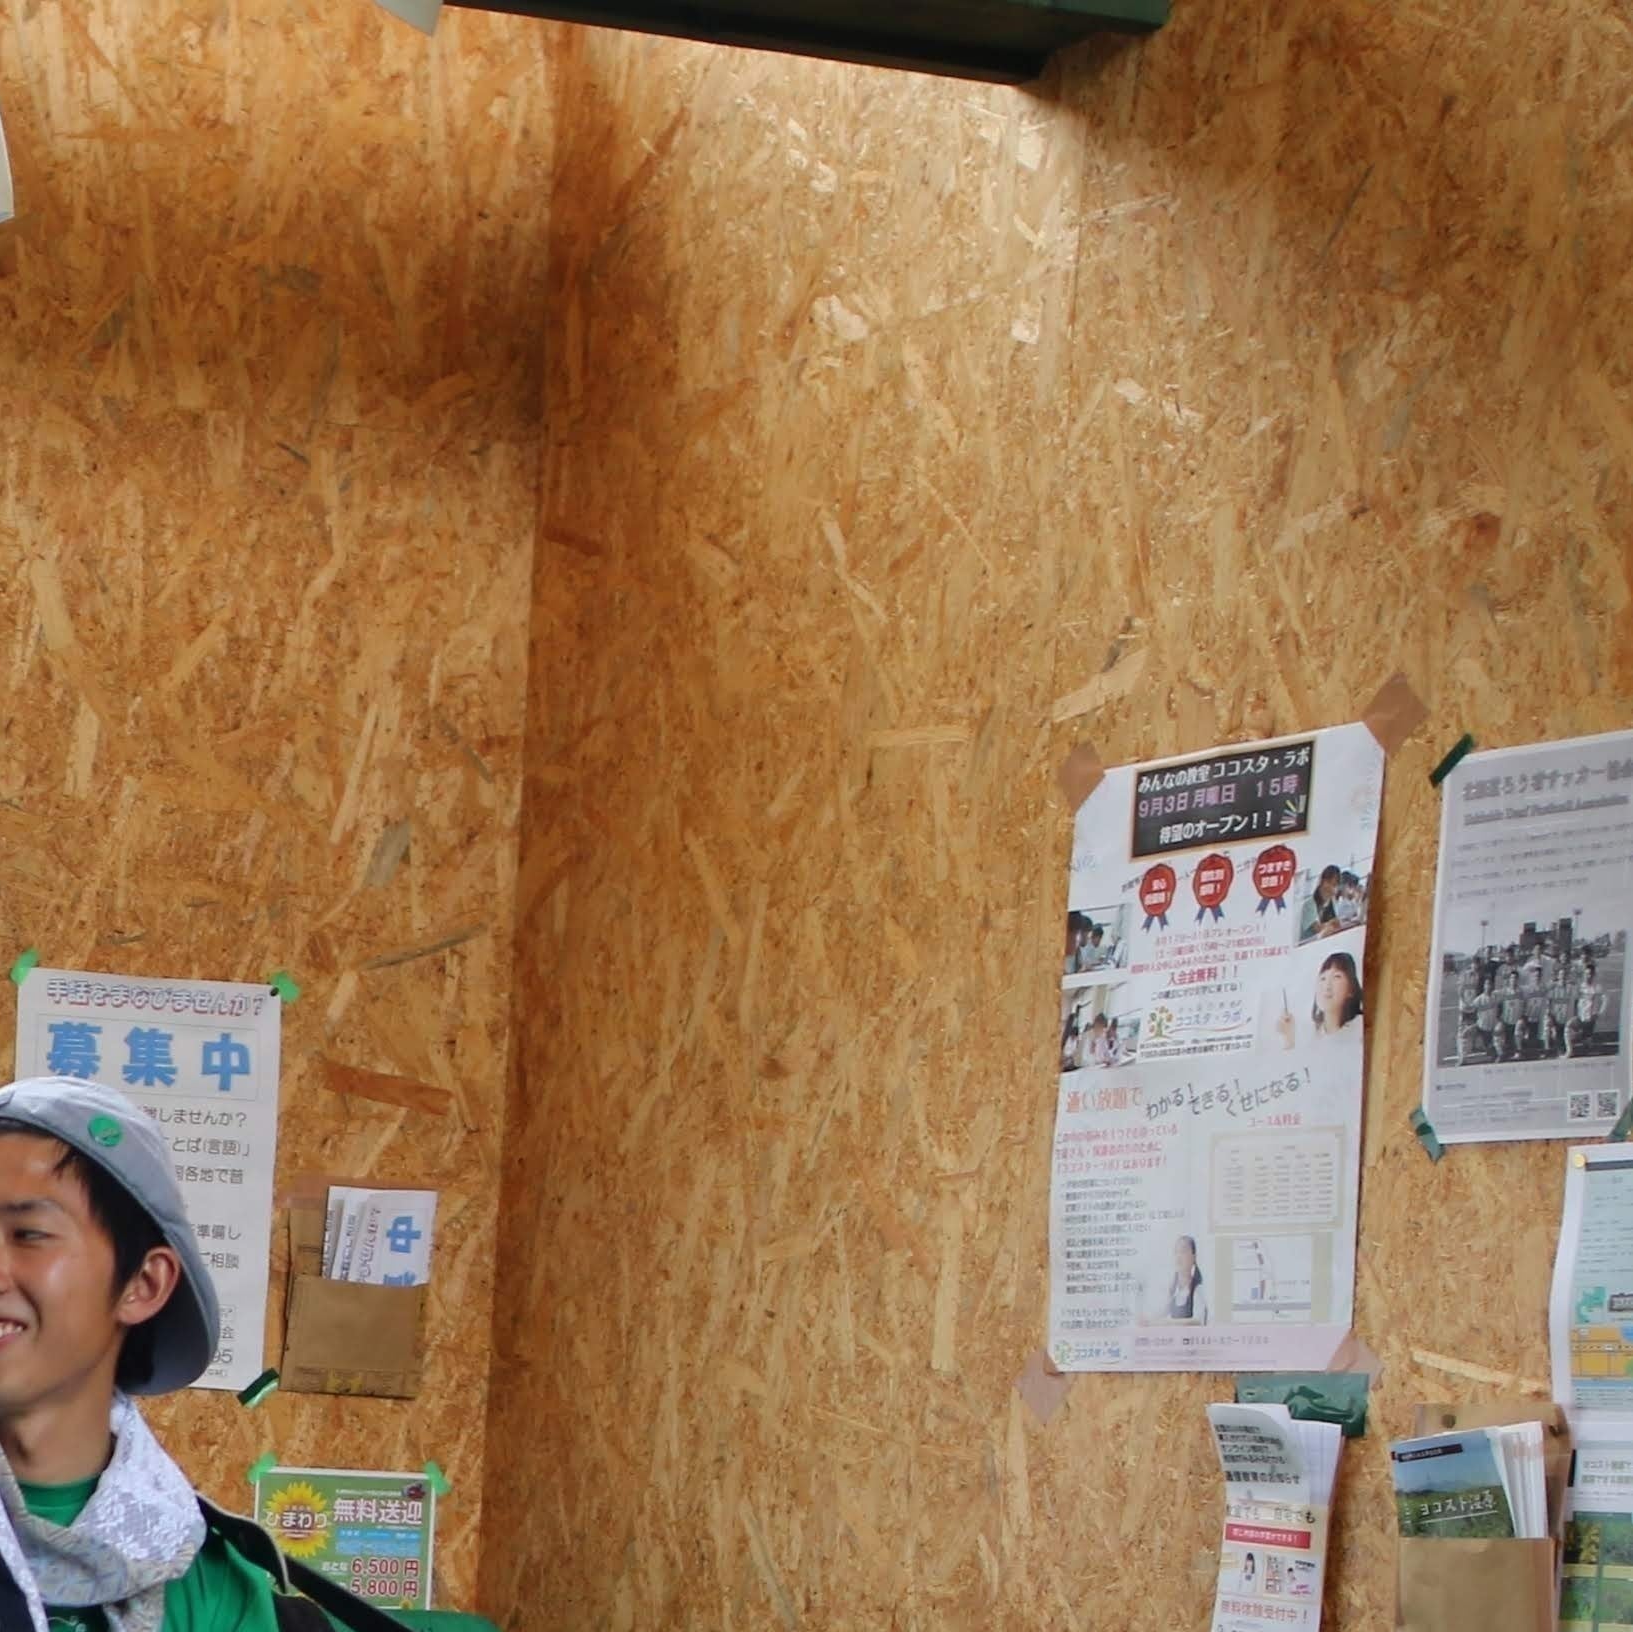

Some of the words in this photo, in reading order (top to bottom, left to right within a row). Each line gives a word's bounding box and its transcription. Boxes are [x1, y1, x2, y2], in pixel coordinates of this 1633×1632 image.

[1138, 766, 1210, 793] みんなの教室
[1214, 747, 1310, 779] ココスタ・ラボ
[47, 1021, 251, 1091] 募集中
[265, 1511, 328, 1529] ひまわり
[333, 1498, 423, 1525] 無料送迎
[403, 1560, 420, 1577] 円
[402, 1580, 419, 1597] 円
